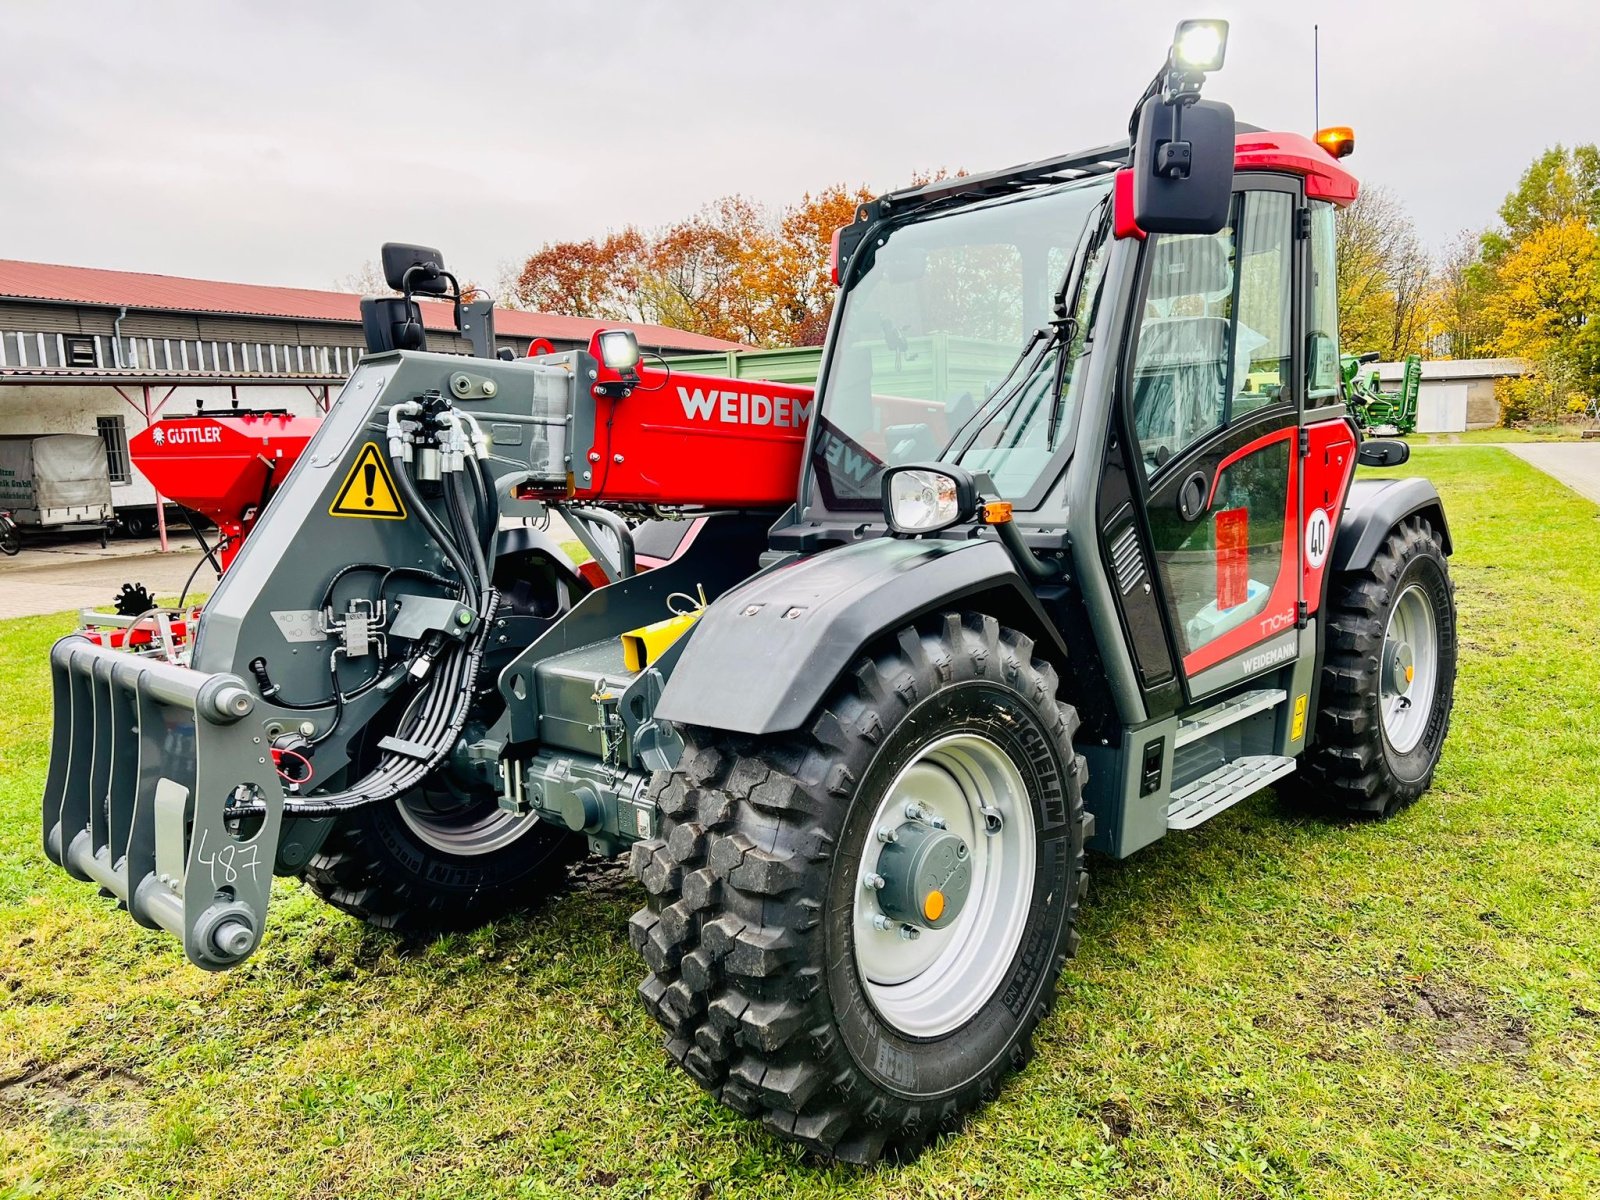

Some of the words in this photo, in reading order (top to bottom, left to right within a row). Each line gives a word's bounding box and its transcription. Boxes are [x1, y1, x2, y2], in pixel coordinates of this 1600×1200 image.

[167, 427, 222, 444] GÜTTLER
[1310, 519, 1325, 557] 40
[1260, 607, 1295, 635] T7042
[1242, 642, 1296, 674] WEIDEMANN
[198, 828, 262, 889] 487
[1004, 984, 1018, 1005] IND
